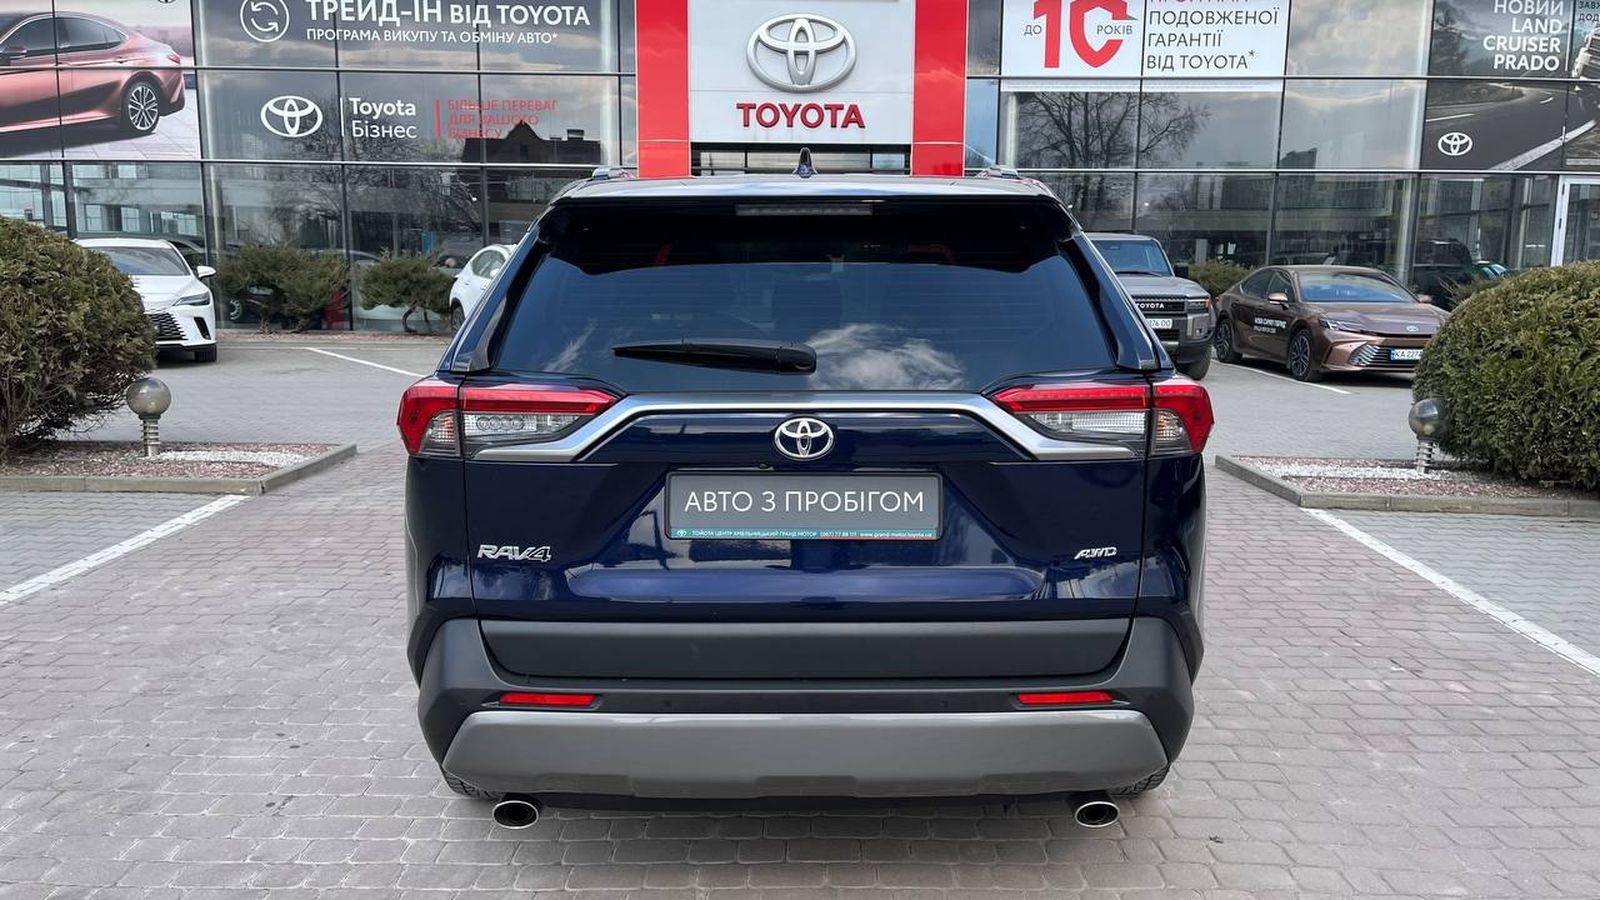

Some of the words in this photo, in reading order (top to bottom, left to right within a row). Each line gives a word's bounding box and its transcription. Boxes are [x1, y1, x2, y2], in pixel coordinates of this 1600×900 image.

[450, 4, 492, 28] ВІД
[496, 5, 591, 26] TOYOTA
[1149, 7, 1280, 28] ПОДОВЖЕНОЇ
[1024, 25, 1042, 36] ДО
[1096, 25, 1133, 35] РОКІВ
[1511, 17, 1563, 34] LAND
[306, 29, 381, 41] ПРОГРАМА
[384, 30, 438, 42] ВИКУПУ
[441, 31, 457, 42] ТА
[460, 31, 514, 43] ОБМІНУ
[1148, 29, 1224, 47] ГАРАНТІЇ
[1483, 35, 1561, 53] CRUISER
[1147, 55, 1174, 72] ВІД
[1493, 54, 1560, 71] PRADO
[348, 97, 416, 119] Toyota
[736, 102, 865, 128] TOYOTA
[352, 120, 417, 138] Бізнес
[684, 491, 753, 512] АВТО
[761, 491, 776, 512] З
[785, 491, 924, 512] ПРОБІГОМ
[476, 545, 552, 562] RAV4
[1074, 547, 1118, 559] AWD
